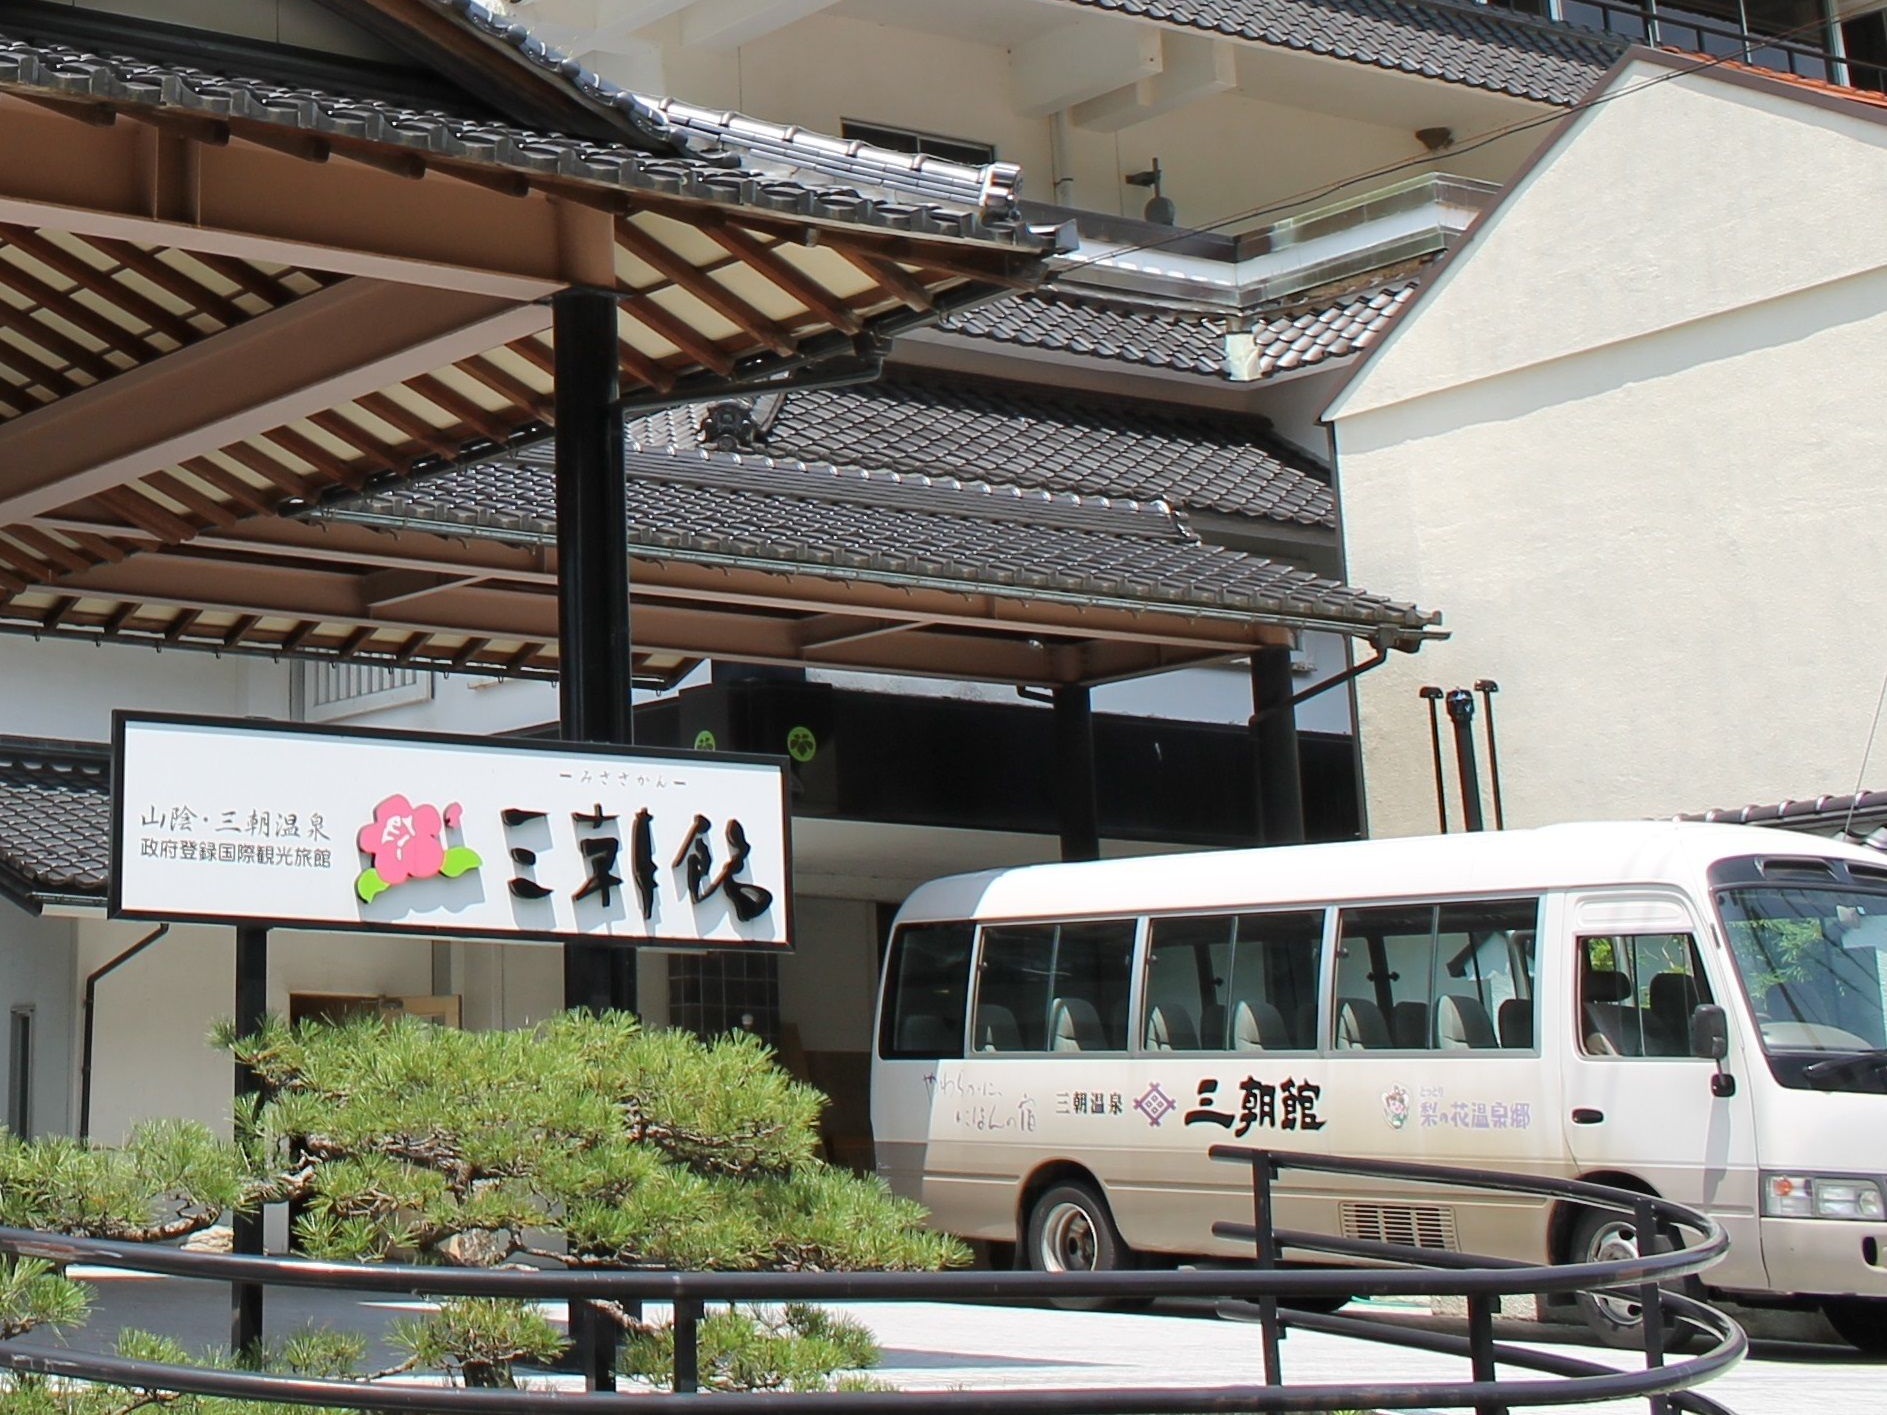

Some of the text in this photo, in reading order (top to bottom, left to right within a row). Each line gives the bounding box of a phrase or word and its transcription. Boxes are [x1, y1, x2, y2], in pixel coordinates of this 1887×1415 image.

[141, 805, 331, 842] 山陰・三朝温泉
[140, 838, 332, 868] 政府登録国際観光旅館
[501, 803, 773, 922] 三朝館
[956, 1093, 1036, 1132] にほんの宿
[1055, 1091, 1123, 1115] 三朝温泉
[1184, 1075, 1328, 1138] 三朝館
[1420, 1101, 1531, 1129] 梨の花温泉郷
